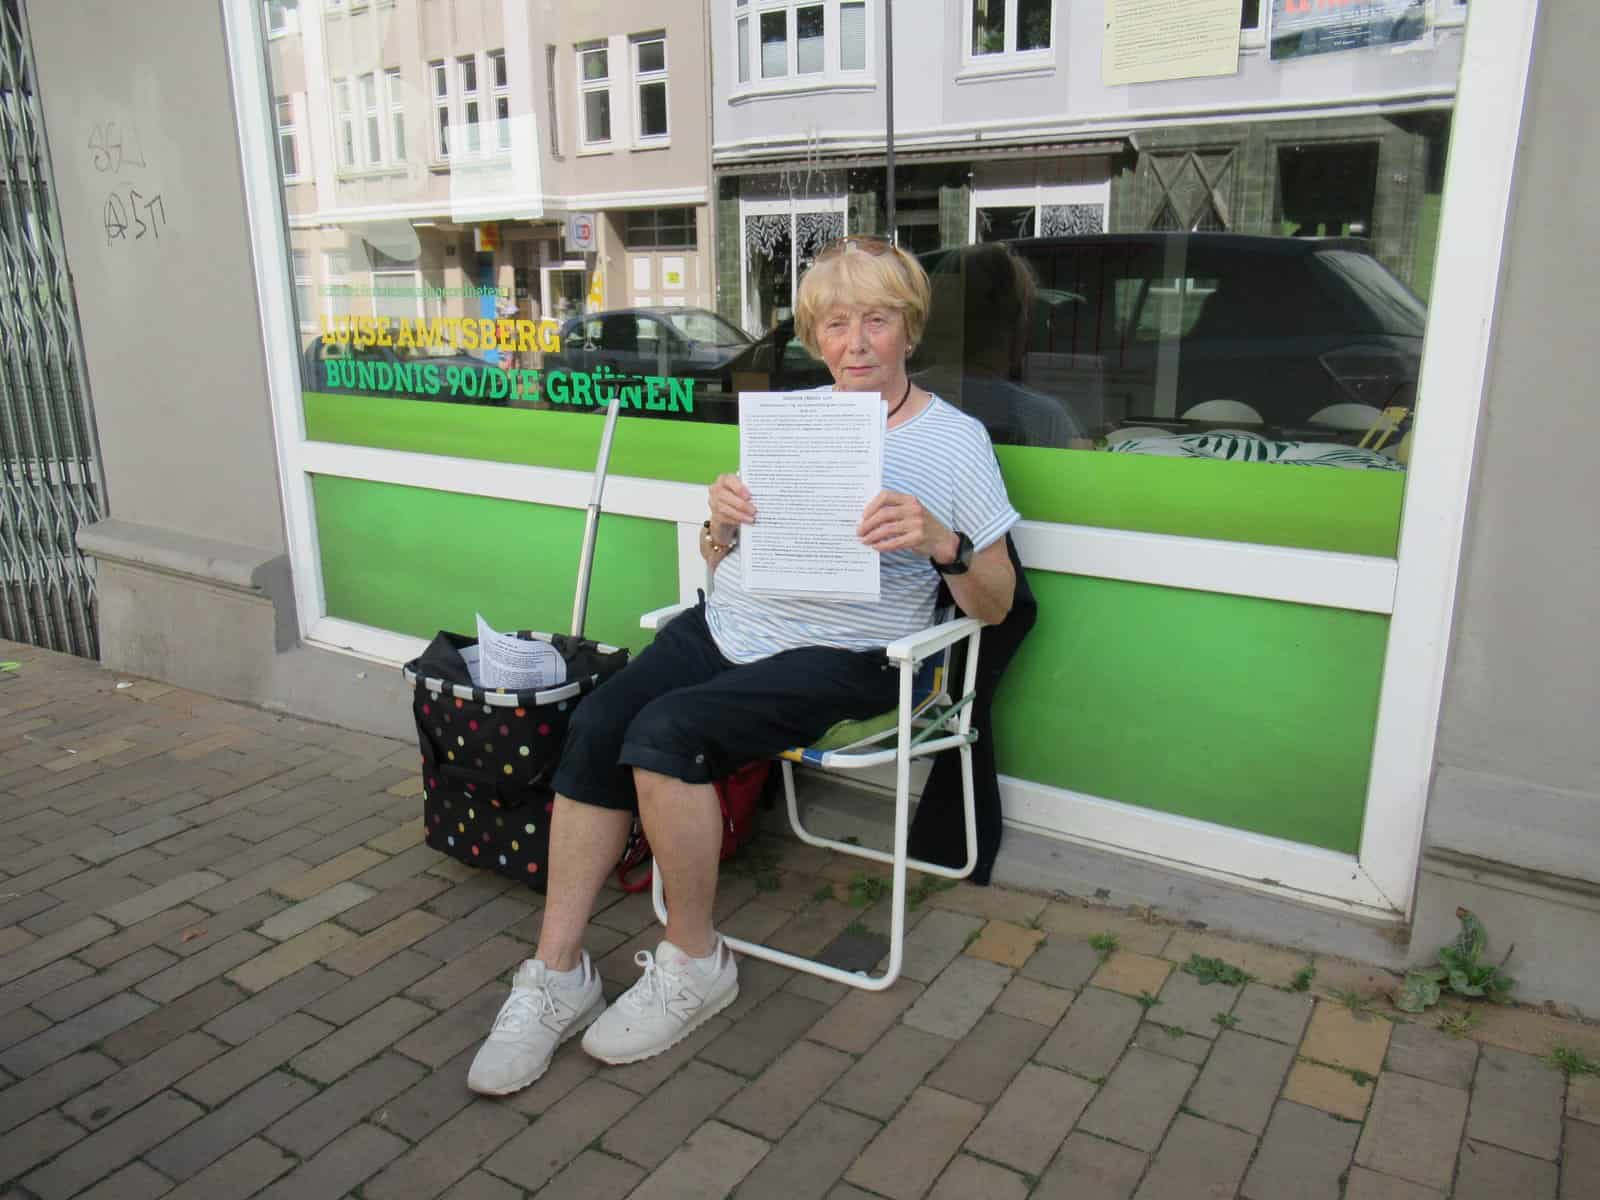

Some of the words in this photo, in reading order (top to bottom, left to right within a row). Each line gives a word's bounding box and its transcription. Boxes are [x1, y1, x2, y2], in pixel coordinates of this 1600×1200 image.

[320, 314, 392, 347] LUISE
[397, 316, 561, 353] AMTSBERG
[325, 353, 440, 395] BÜNDNIS
[446, 365, 540, 402] 90/DIE
[546, 365, 695, 413] GRÜNEN
